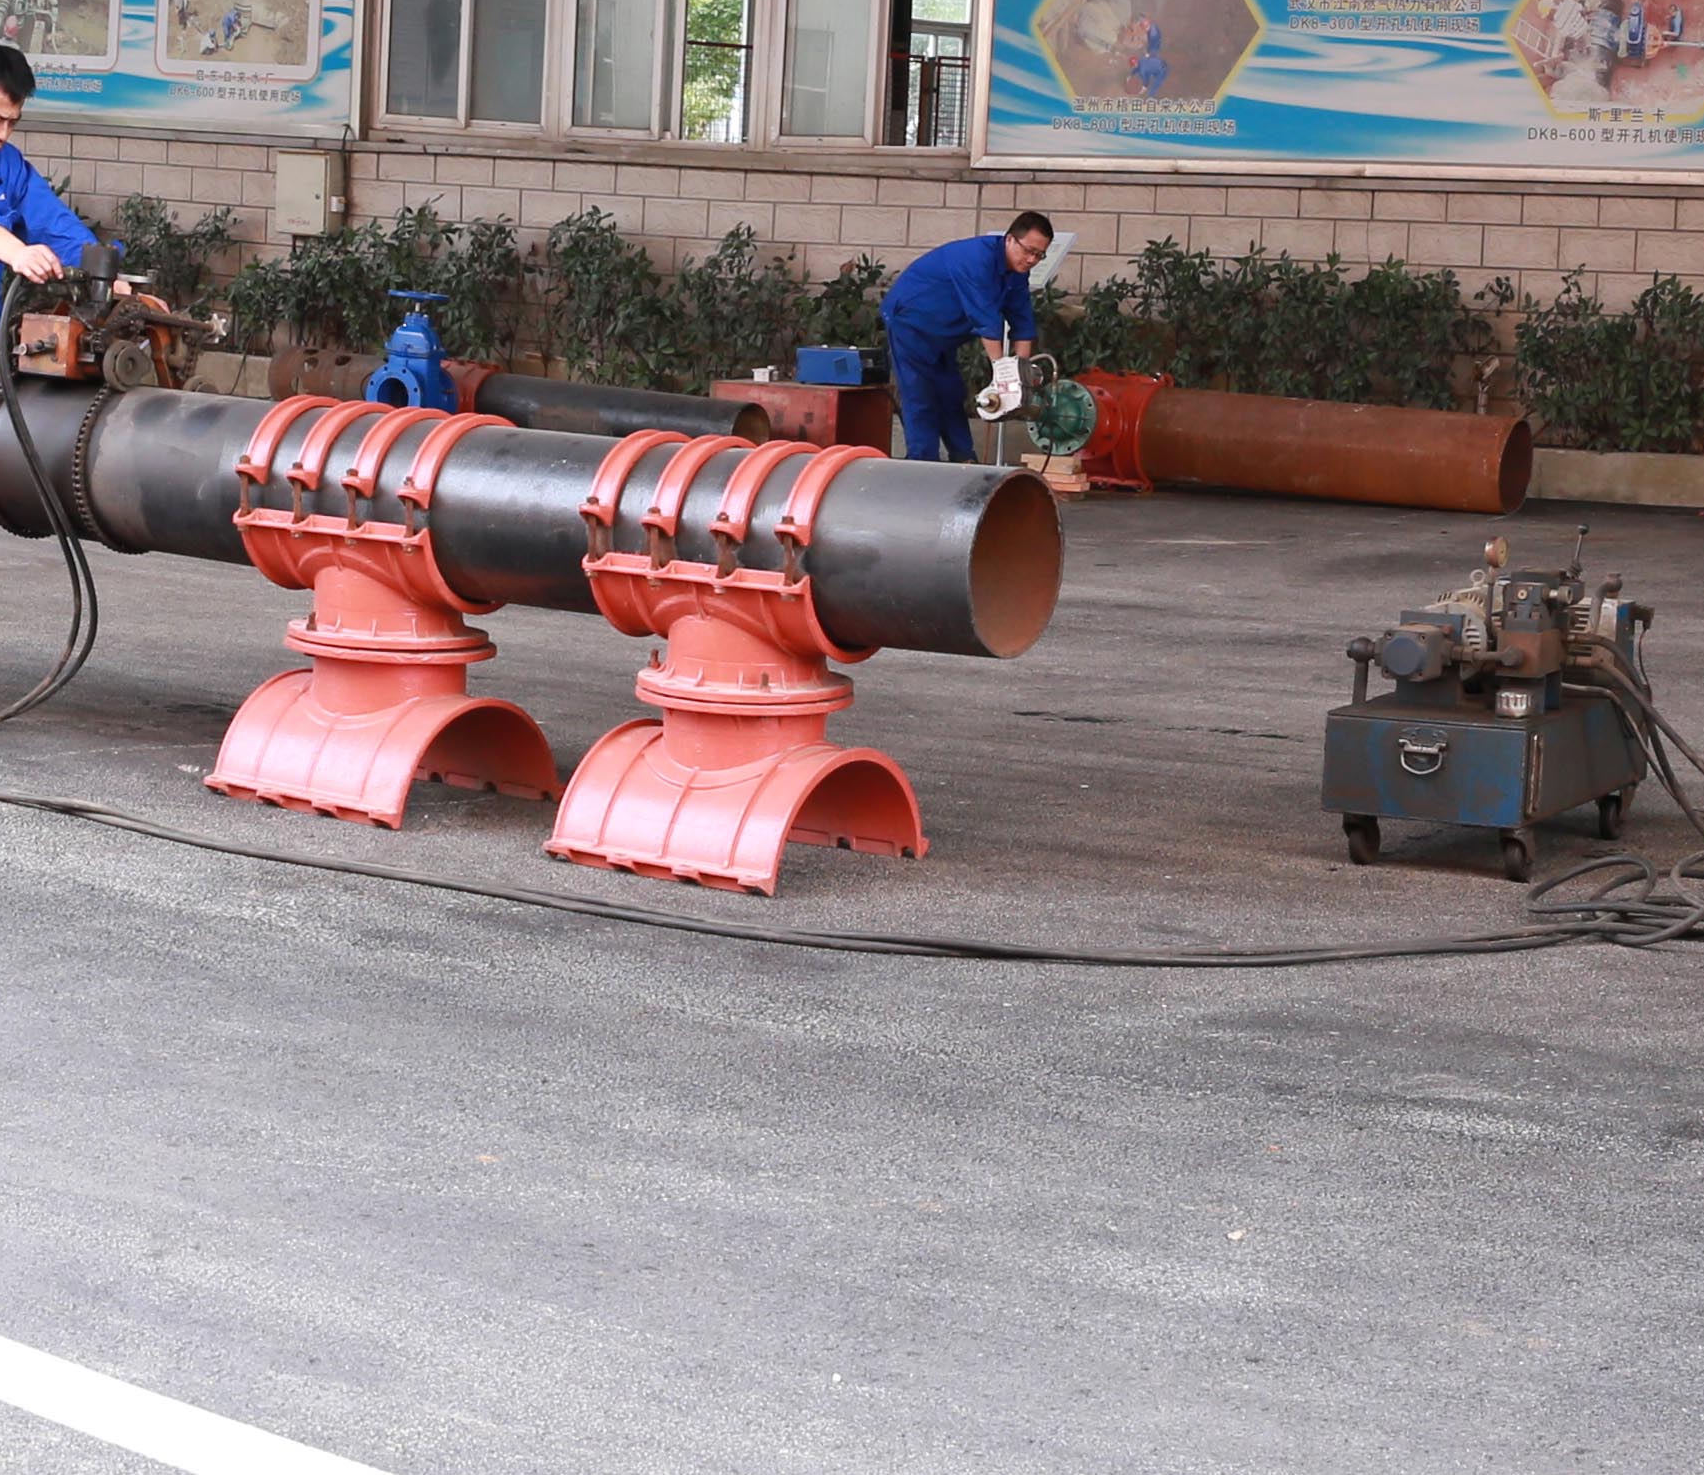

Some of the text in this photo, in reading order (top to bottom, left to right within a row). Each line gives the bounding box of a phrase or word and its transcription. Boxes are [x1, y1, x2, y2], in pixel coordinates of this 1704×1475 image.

[1359, 16, 1480, 32] 型开孔机使用现场
[1073, 97, 1216, 114] 温州市梧田自来水公司
[1588, 108, 1667, 123] 斯里兰卡
[1120, 118, 1236, 134] 型开孔机使用现场
[1528, 127, 1595, 141] DK8-600
